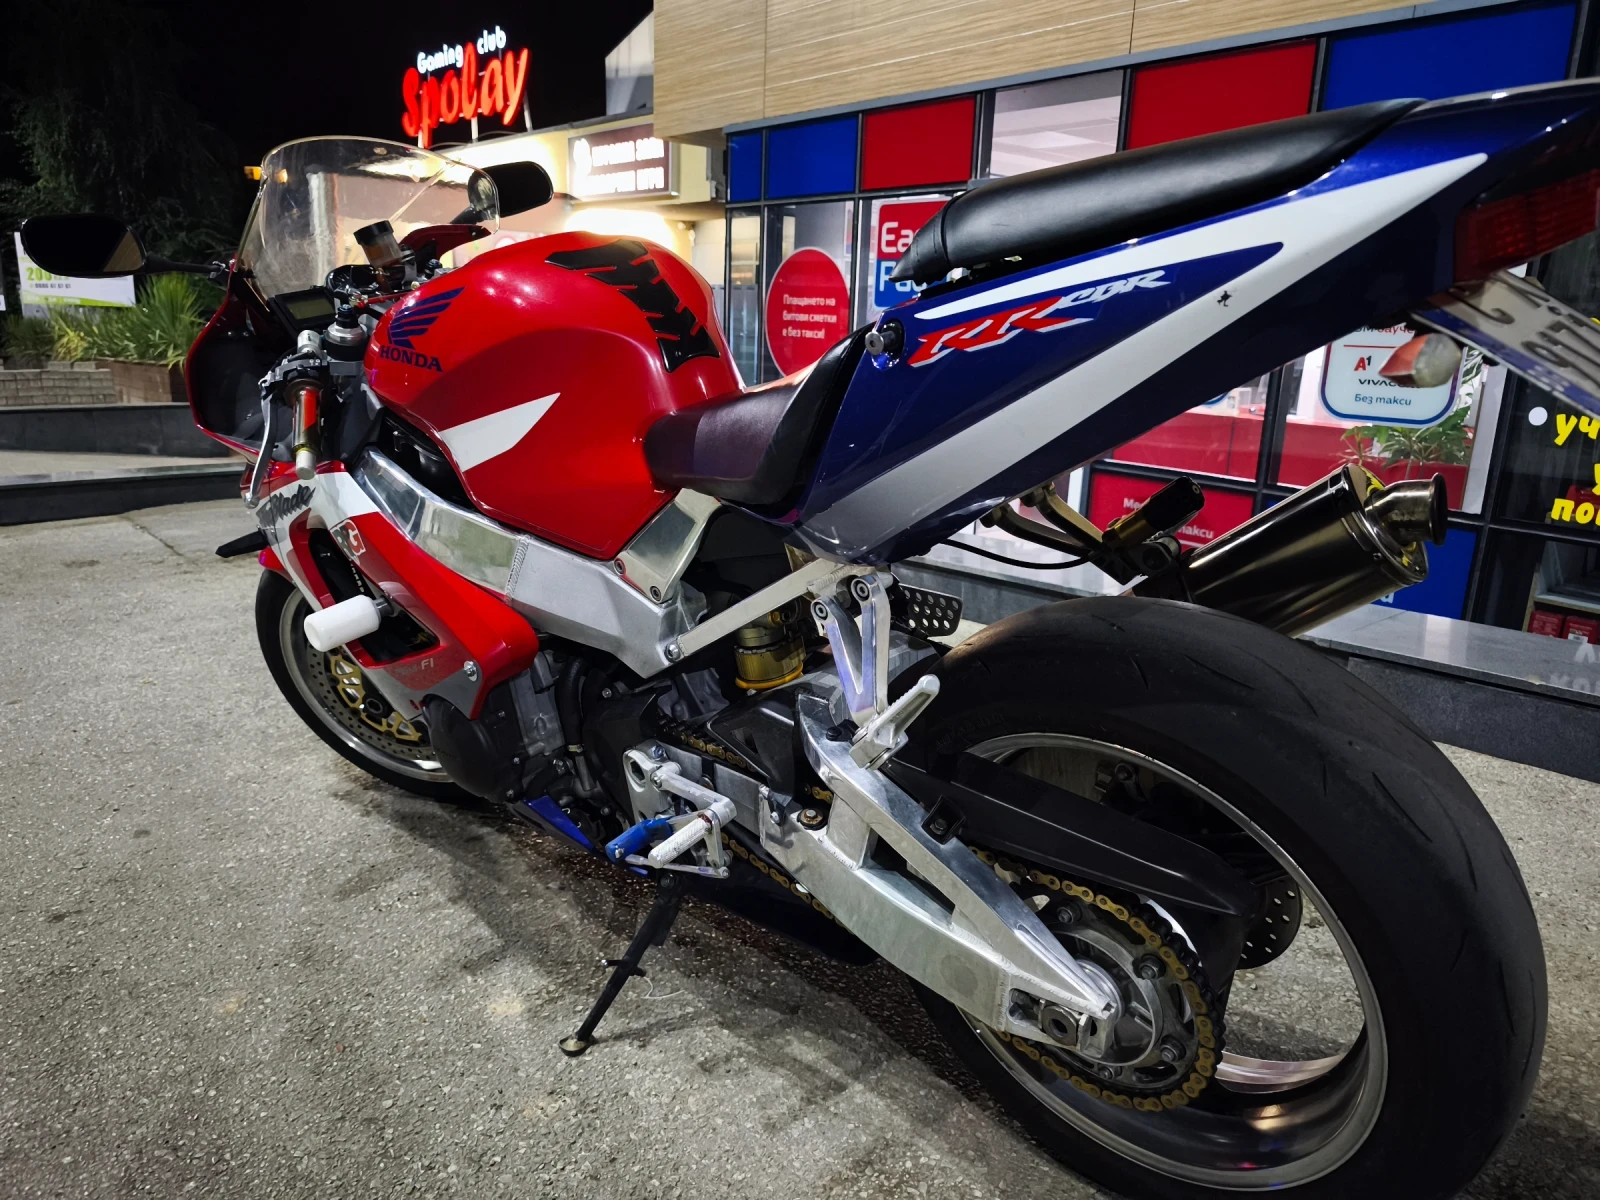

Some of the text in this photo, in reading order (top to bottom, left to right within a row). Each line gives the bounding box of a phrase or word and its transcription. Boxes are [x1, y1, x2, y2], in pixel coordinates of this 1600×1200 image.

[417, 25, 507, 74] Gaming club
[380, 345, 444, 373] HONDA
[1353, 355, 1372, 372] A1
[1354, 393, 1412, 406] Без такси
